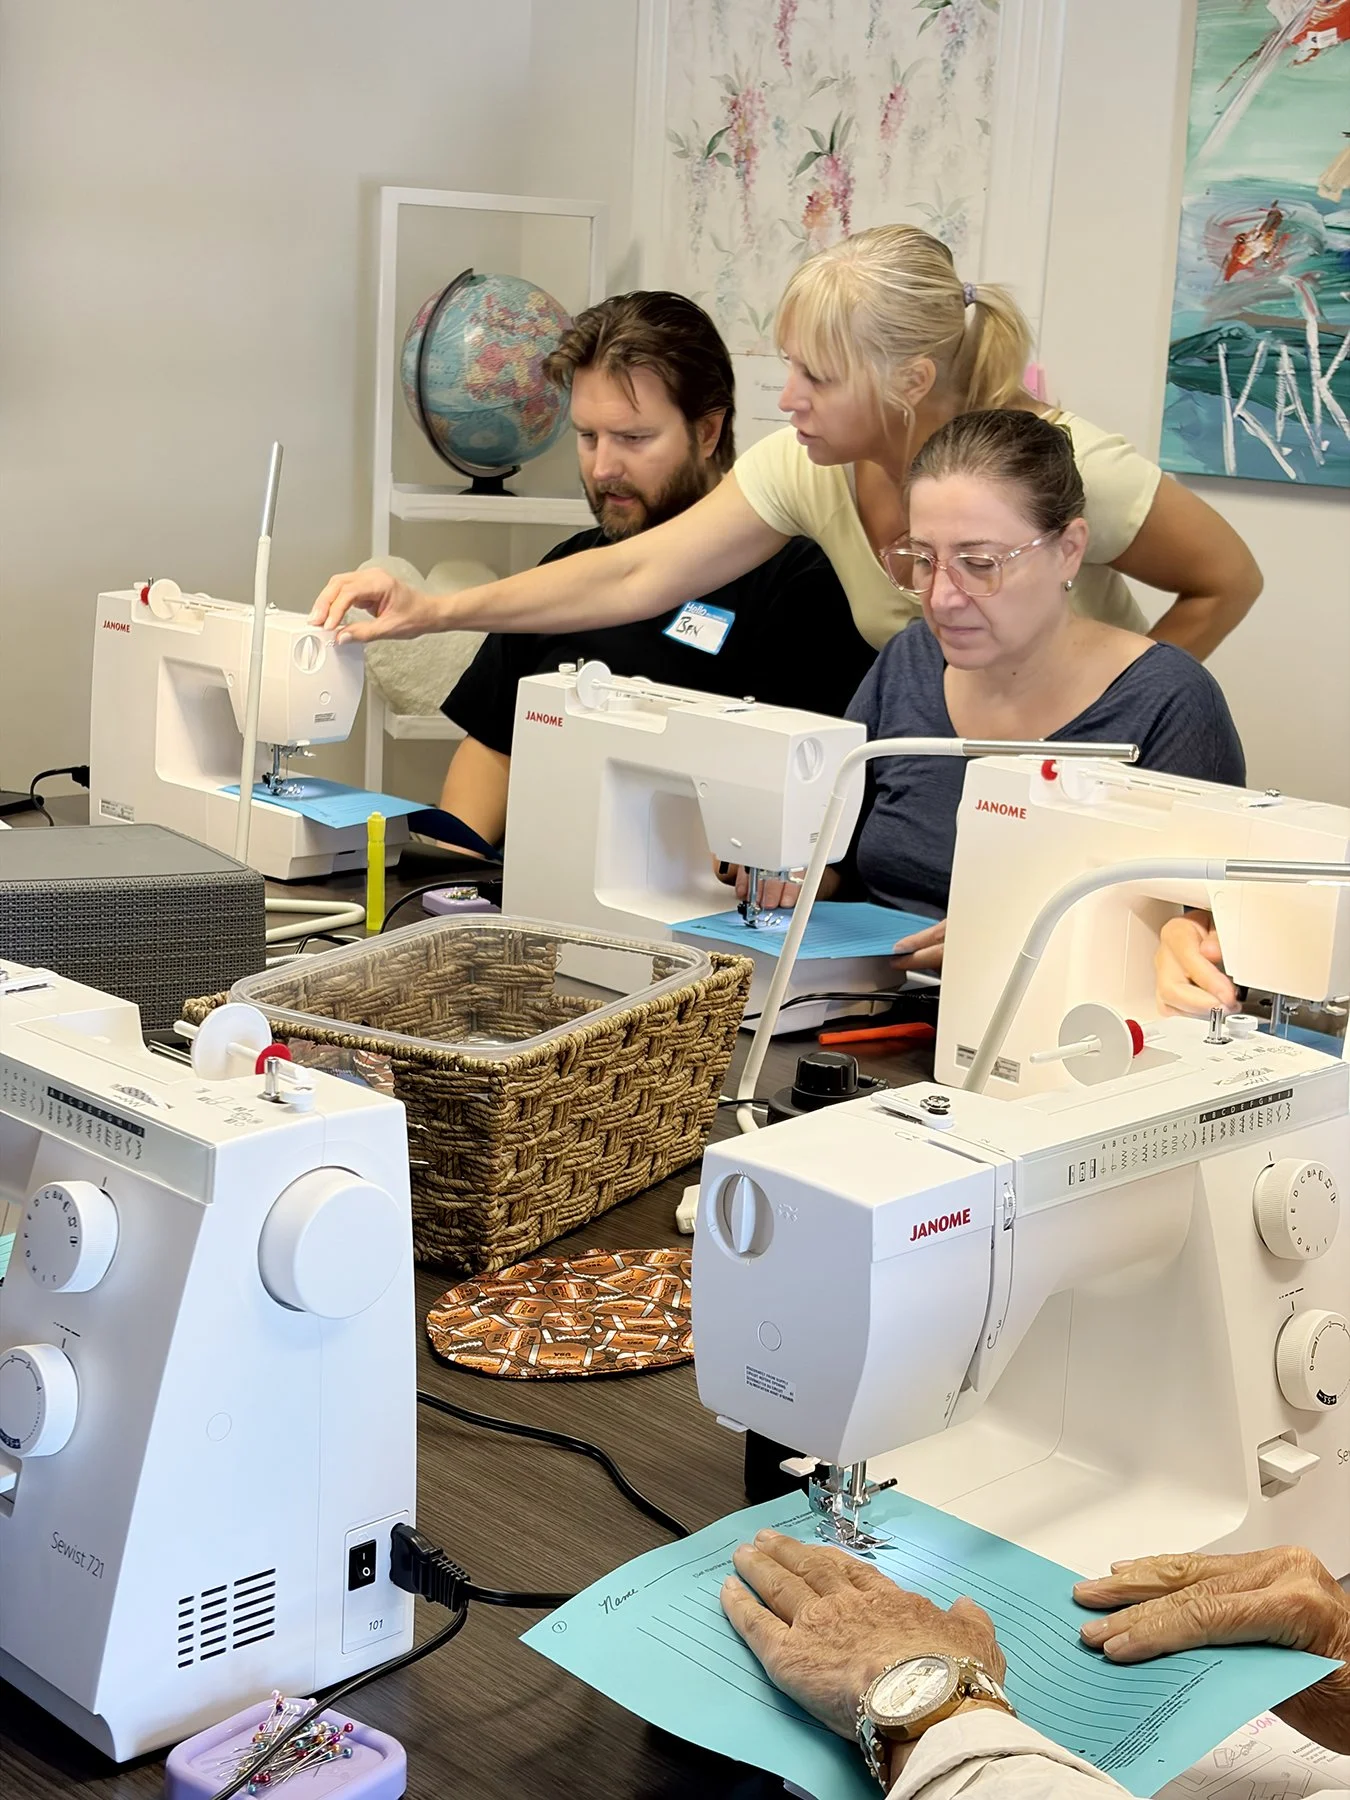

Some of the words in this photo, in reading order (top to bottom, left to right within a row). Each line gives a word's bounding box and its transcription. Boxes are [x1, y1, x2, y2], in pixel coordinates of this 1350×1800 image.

[684, 602, 708, 616] Hello
[103, 620, 130, 633] JANOME
[525, 710, 563, 727] JANOME
[975, 799, 1027, 820] JANOME
[909, 1208, 971, 1242] JANOME
[1337, 1448, 1350, 1465] Se
[51, 1531, 86, 1568] Sewist
[87, 1554, 104, 1579] 721
[598, 1587, 639, 1615] Name
[368, 1619, 384, 1631] 101
